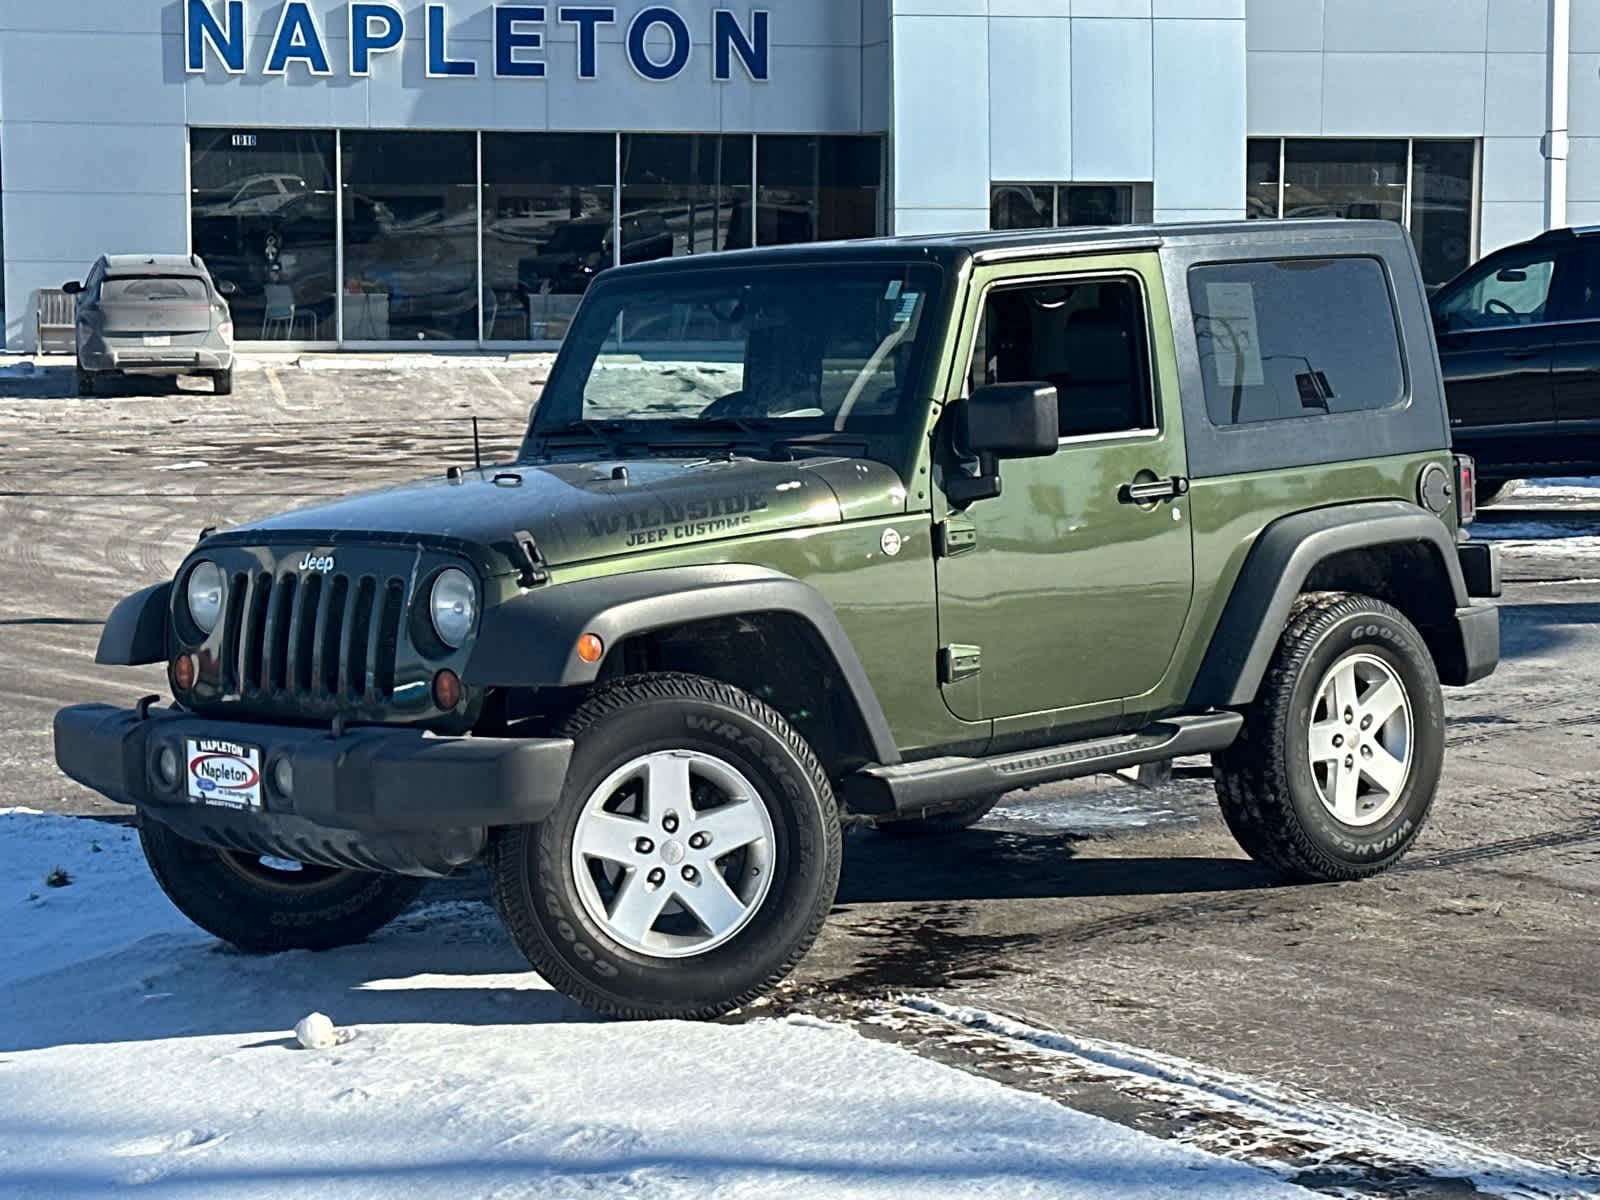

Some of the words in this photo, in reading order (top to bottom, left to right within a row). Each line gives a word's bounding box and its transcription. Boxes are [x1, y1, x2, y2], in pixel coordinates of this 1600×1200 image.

[184, 0, 768, 82] NAPLETON
[626, 527, 668, 547] JEEP
[674, 515, 751, 540] CUSTOMS
[299, 552, 334, 574] Jeep
[200, 740, 244, 756] NAPLETON
[201, 761, 248, 783] Napleton
